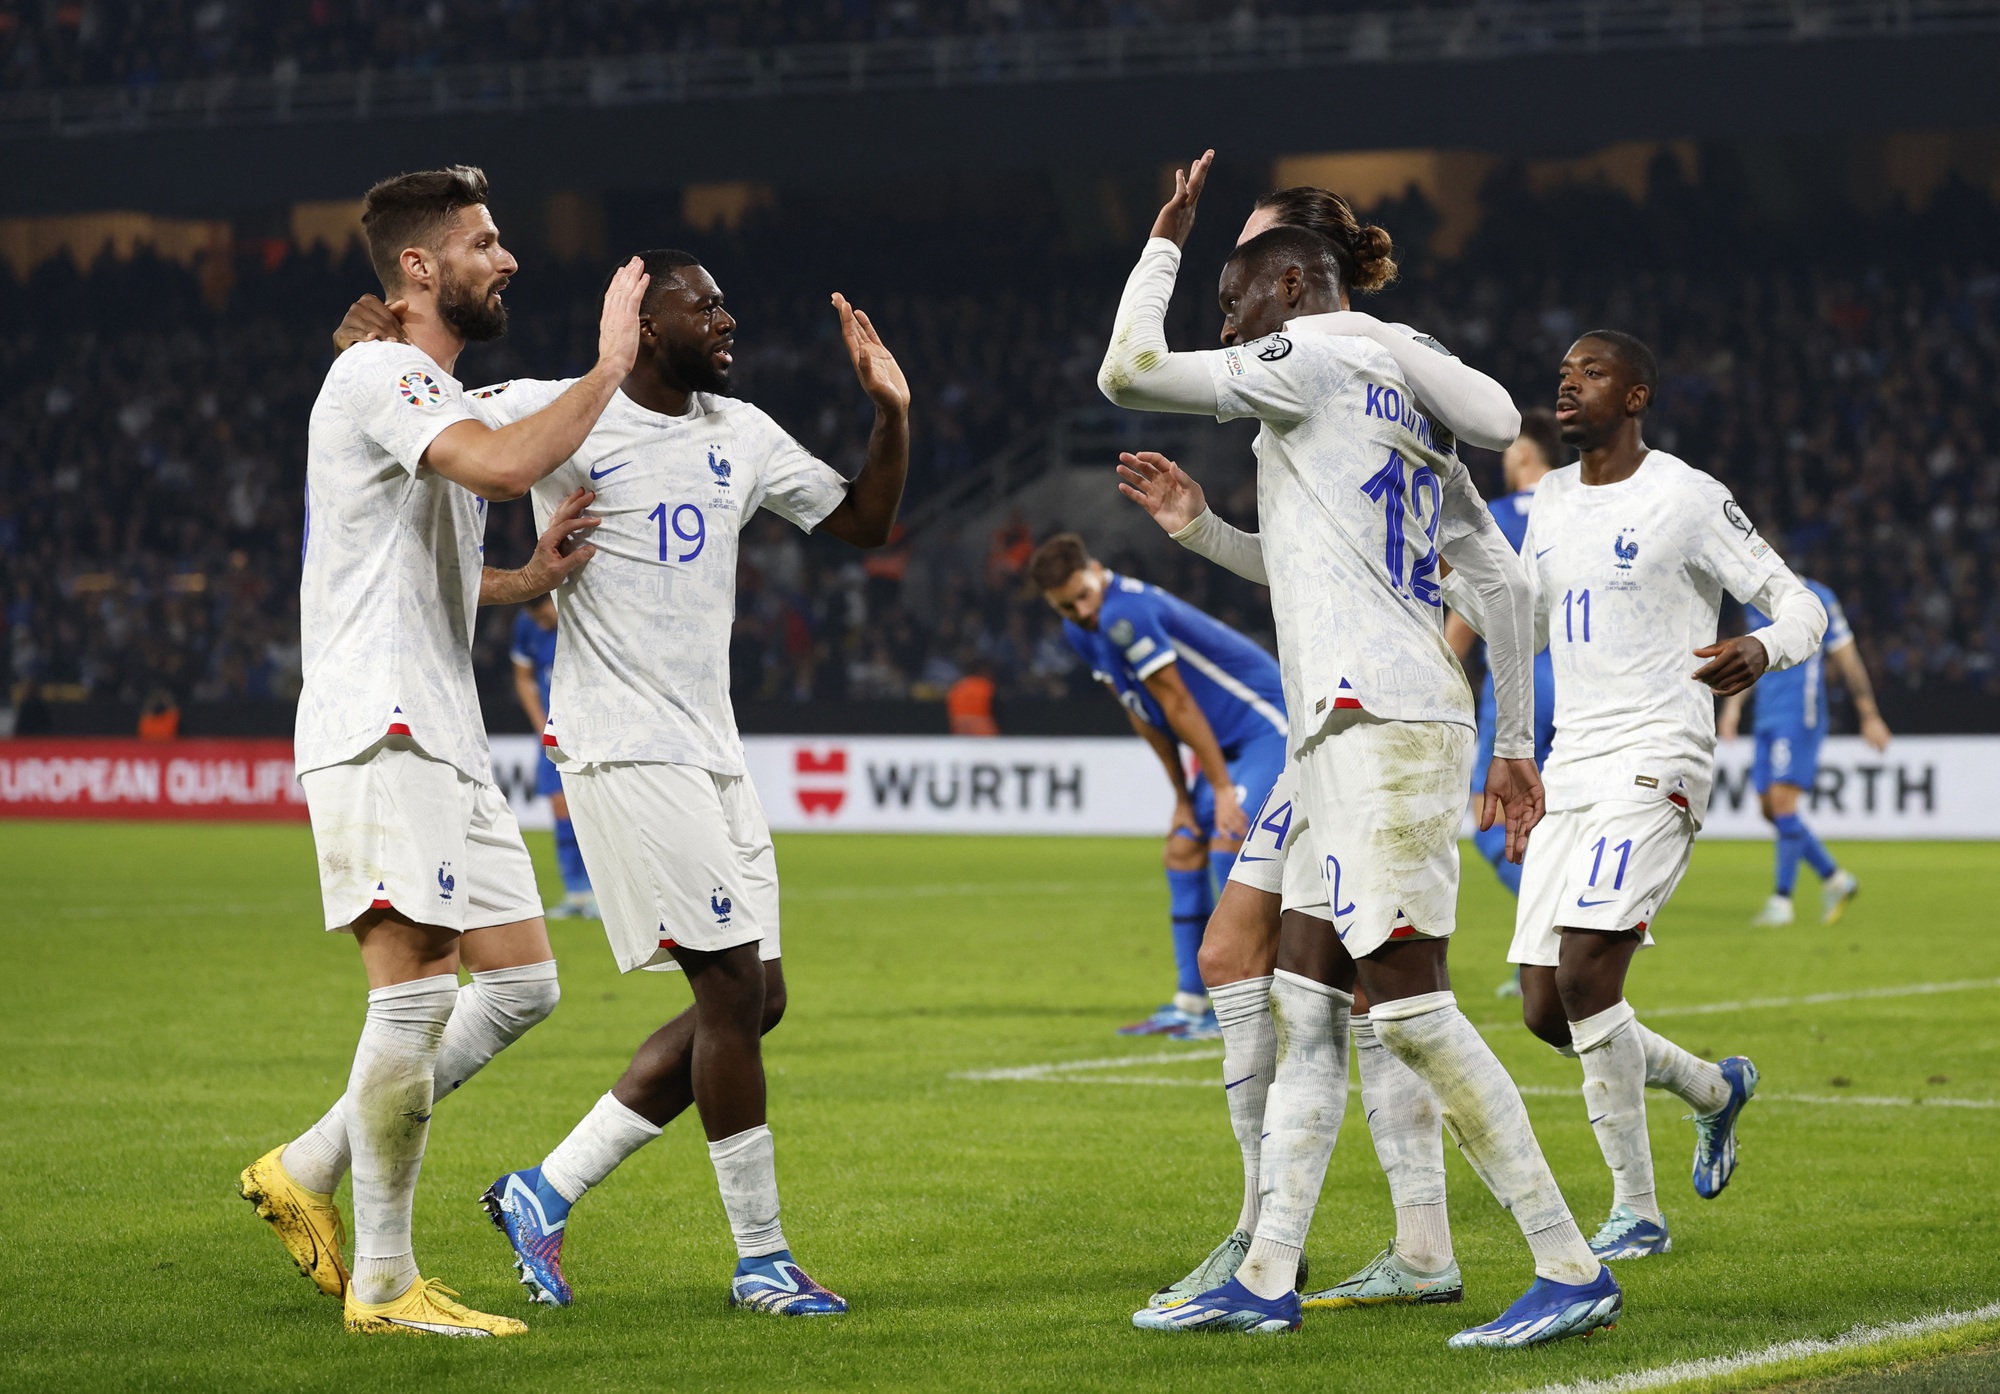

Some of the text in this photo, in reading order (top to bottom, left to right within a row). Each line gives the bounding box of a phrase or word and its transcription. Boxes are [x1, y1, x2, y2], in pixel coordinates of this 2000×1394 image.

[647, 502, 706, 562] 19
[1360, 447, 1442, 608] 12
[1562, 588, 1591, 643] 11
[0, 758, 160, 803] UROPEAN
[1707, 763, 1936, 812] WRTH
[1246, 788, 1293, 850] 14
[1320, 854, 1356, 918] 2
[1588, 836, 1633, 890] 11
